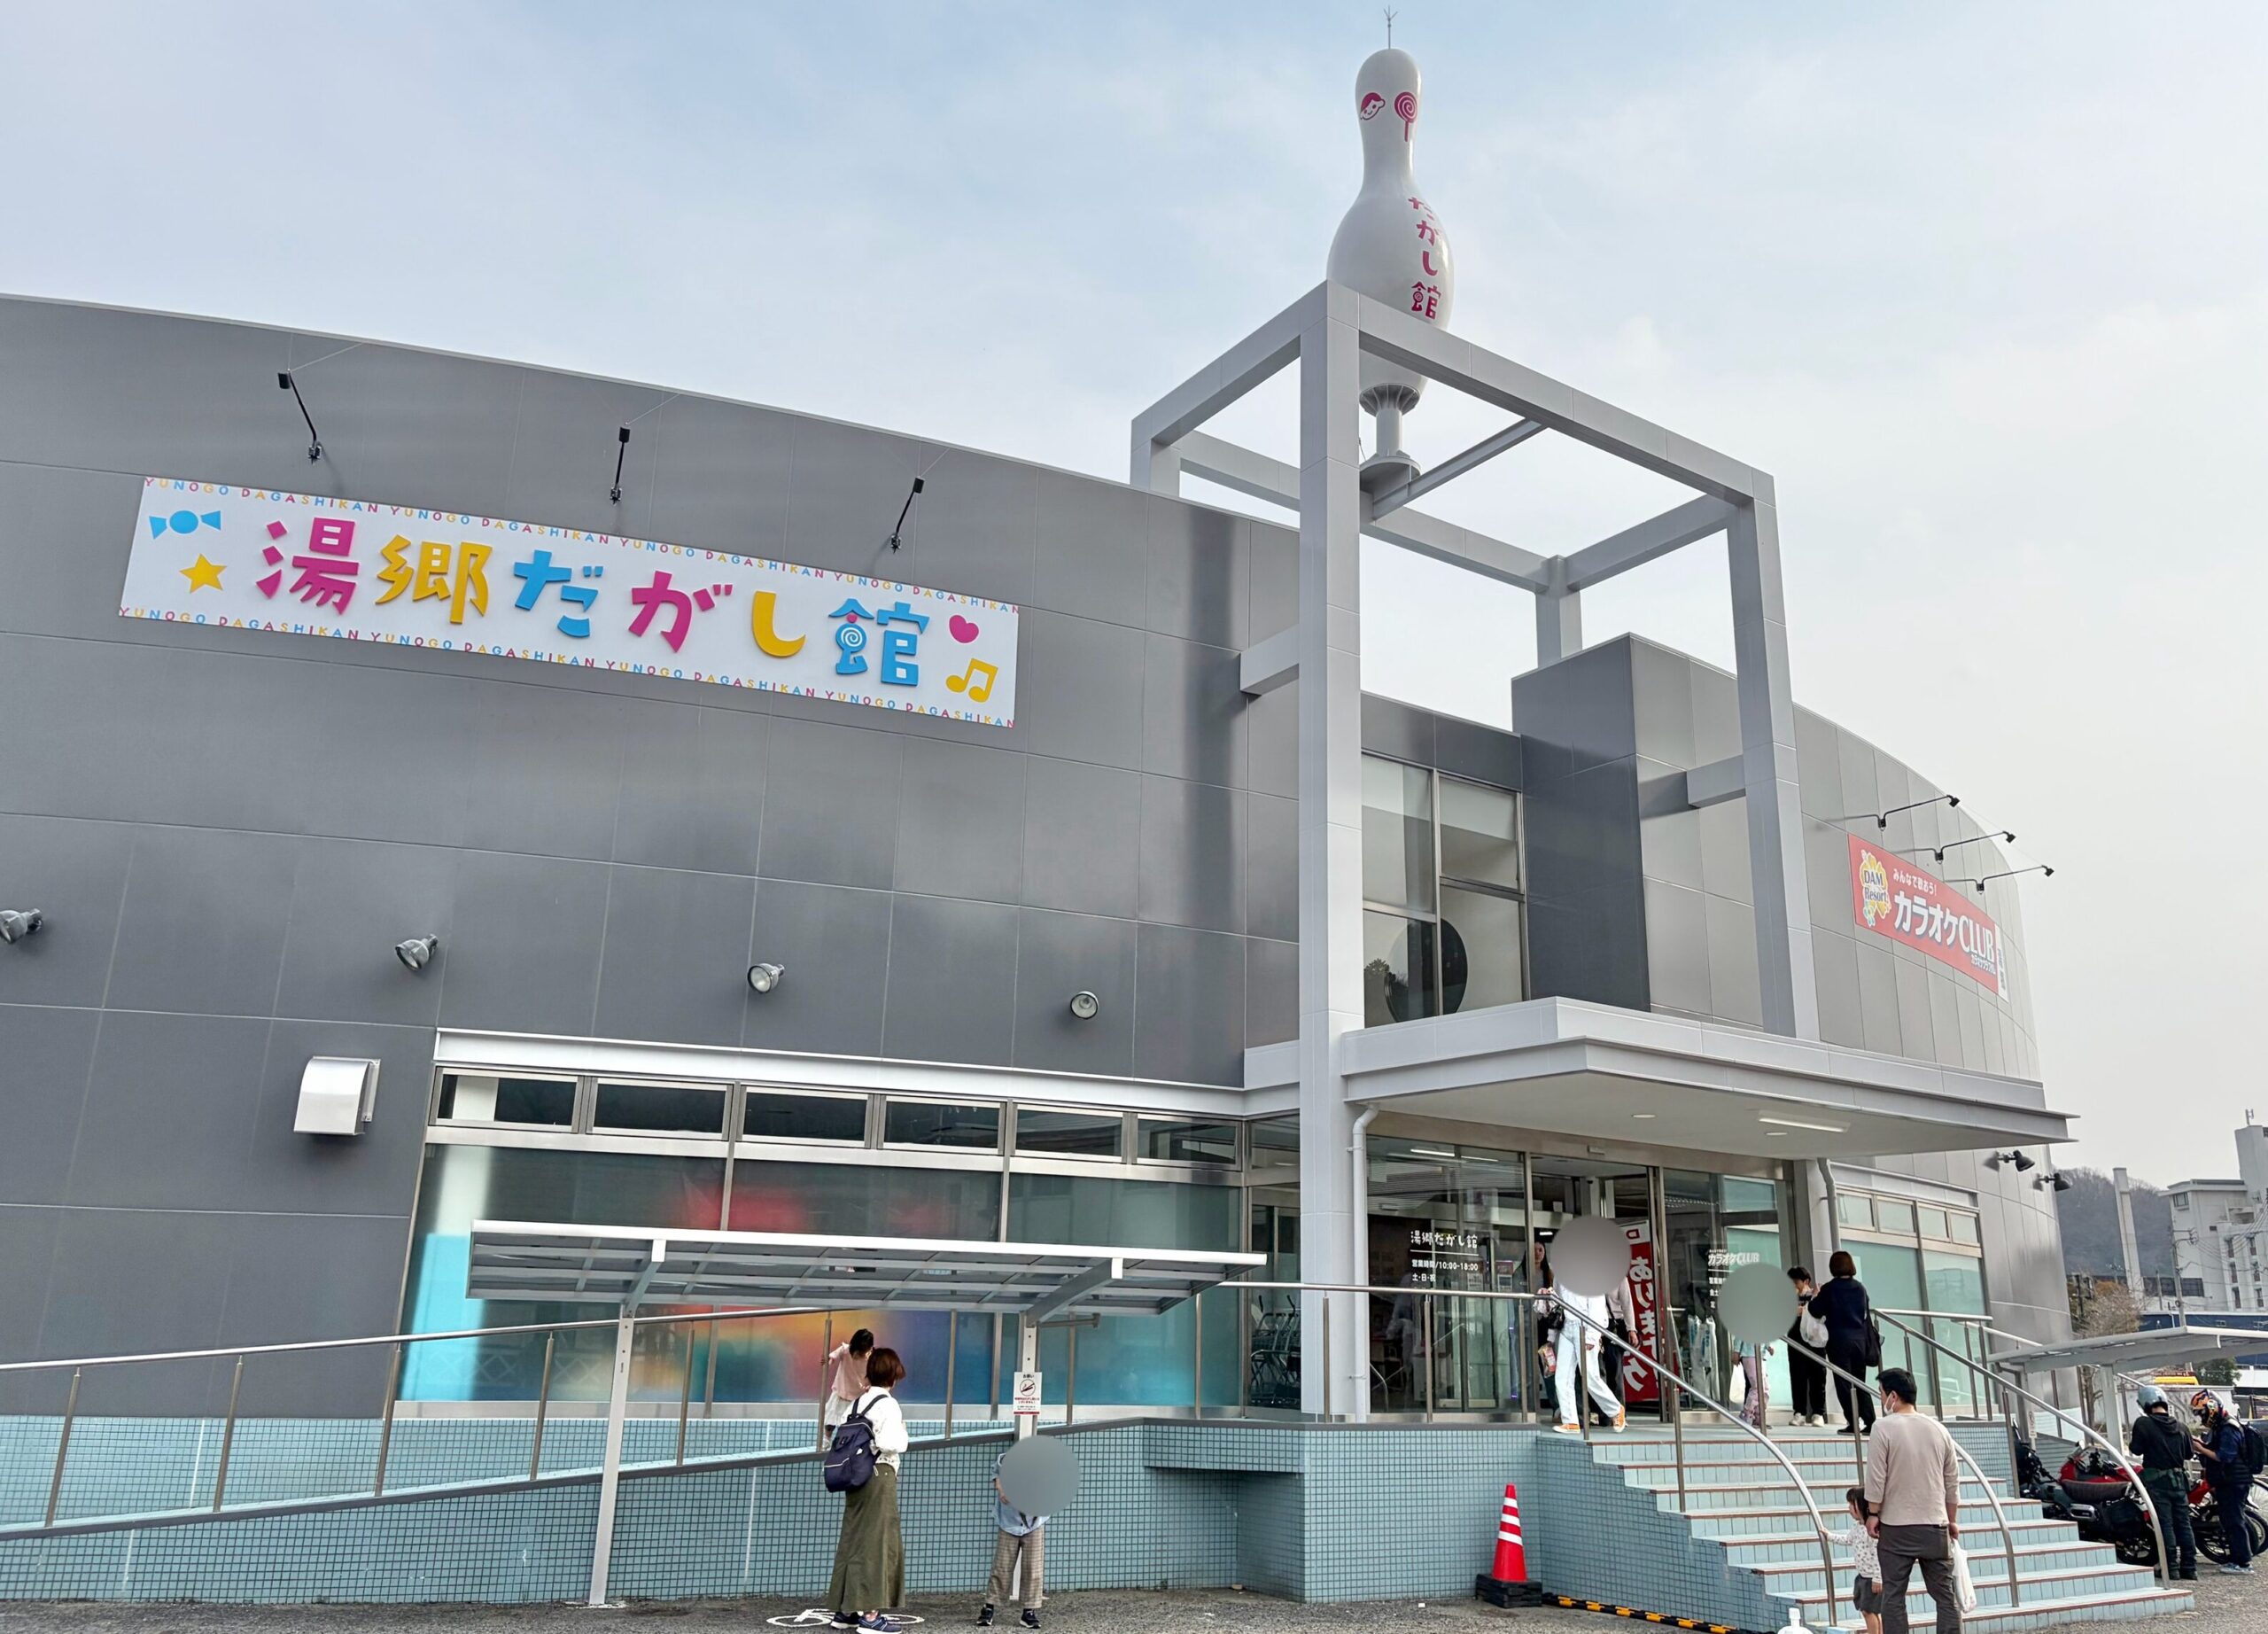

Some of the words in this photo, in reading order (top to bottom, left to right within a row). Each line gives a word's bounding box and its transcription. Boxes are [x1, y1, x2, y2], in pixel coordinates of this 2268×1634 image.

[144, 478, 229, 495] YUNOGO
[242, 488, 378, 513] DAGASHIKAN
[391, 506, 470, 525] YUNOGO
[482, 517, 609, 545] DAGASHIKAN
[620, 538, 695, 558] YUNOGO
[706, 550, 824, 579] DAGASHIKAN
[835, 572, 904, 593] YUNOGO
[913, 585, 1020, 614] DAGASHIKAN
[256, 517, 930, 687] 湯郷だがし館
[119, 607, 206, 624] YUNOGO
[219, 616, 359, 641] DAGASHIKAN
[371, 631, 453, 650] YUNOGO
[464, 642, 595, 670] DAGASHIKAN
[606, 660, 683, 680] YUNOGO
[695, 672, 815, 698] DAGASHIKAN
[826, 690, 896, 710] YUNOGO
[906, 701, 1015, 728] DAGASHIKAN
[1864, 869, 1884, 886] DAM
[1894, 890, 1995, 964] カラオケCLUB
[1410, 1230, 1478, 1249] 湯郷だがし館
[1708, 1251, 1760, 1267] カラオケCLUB
